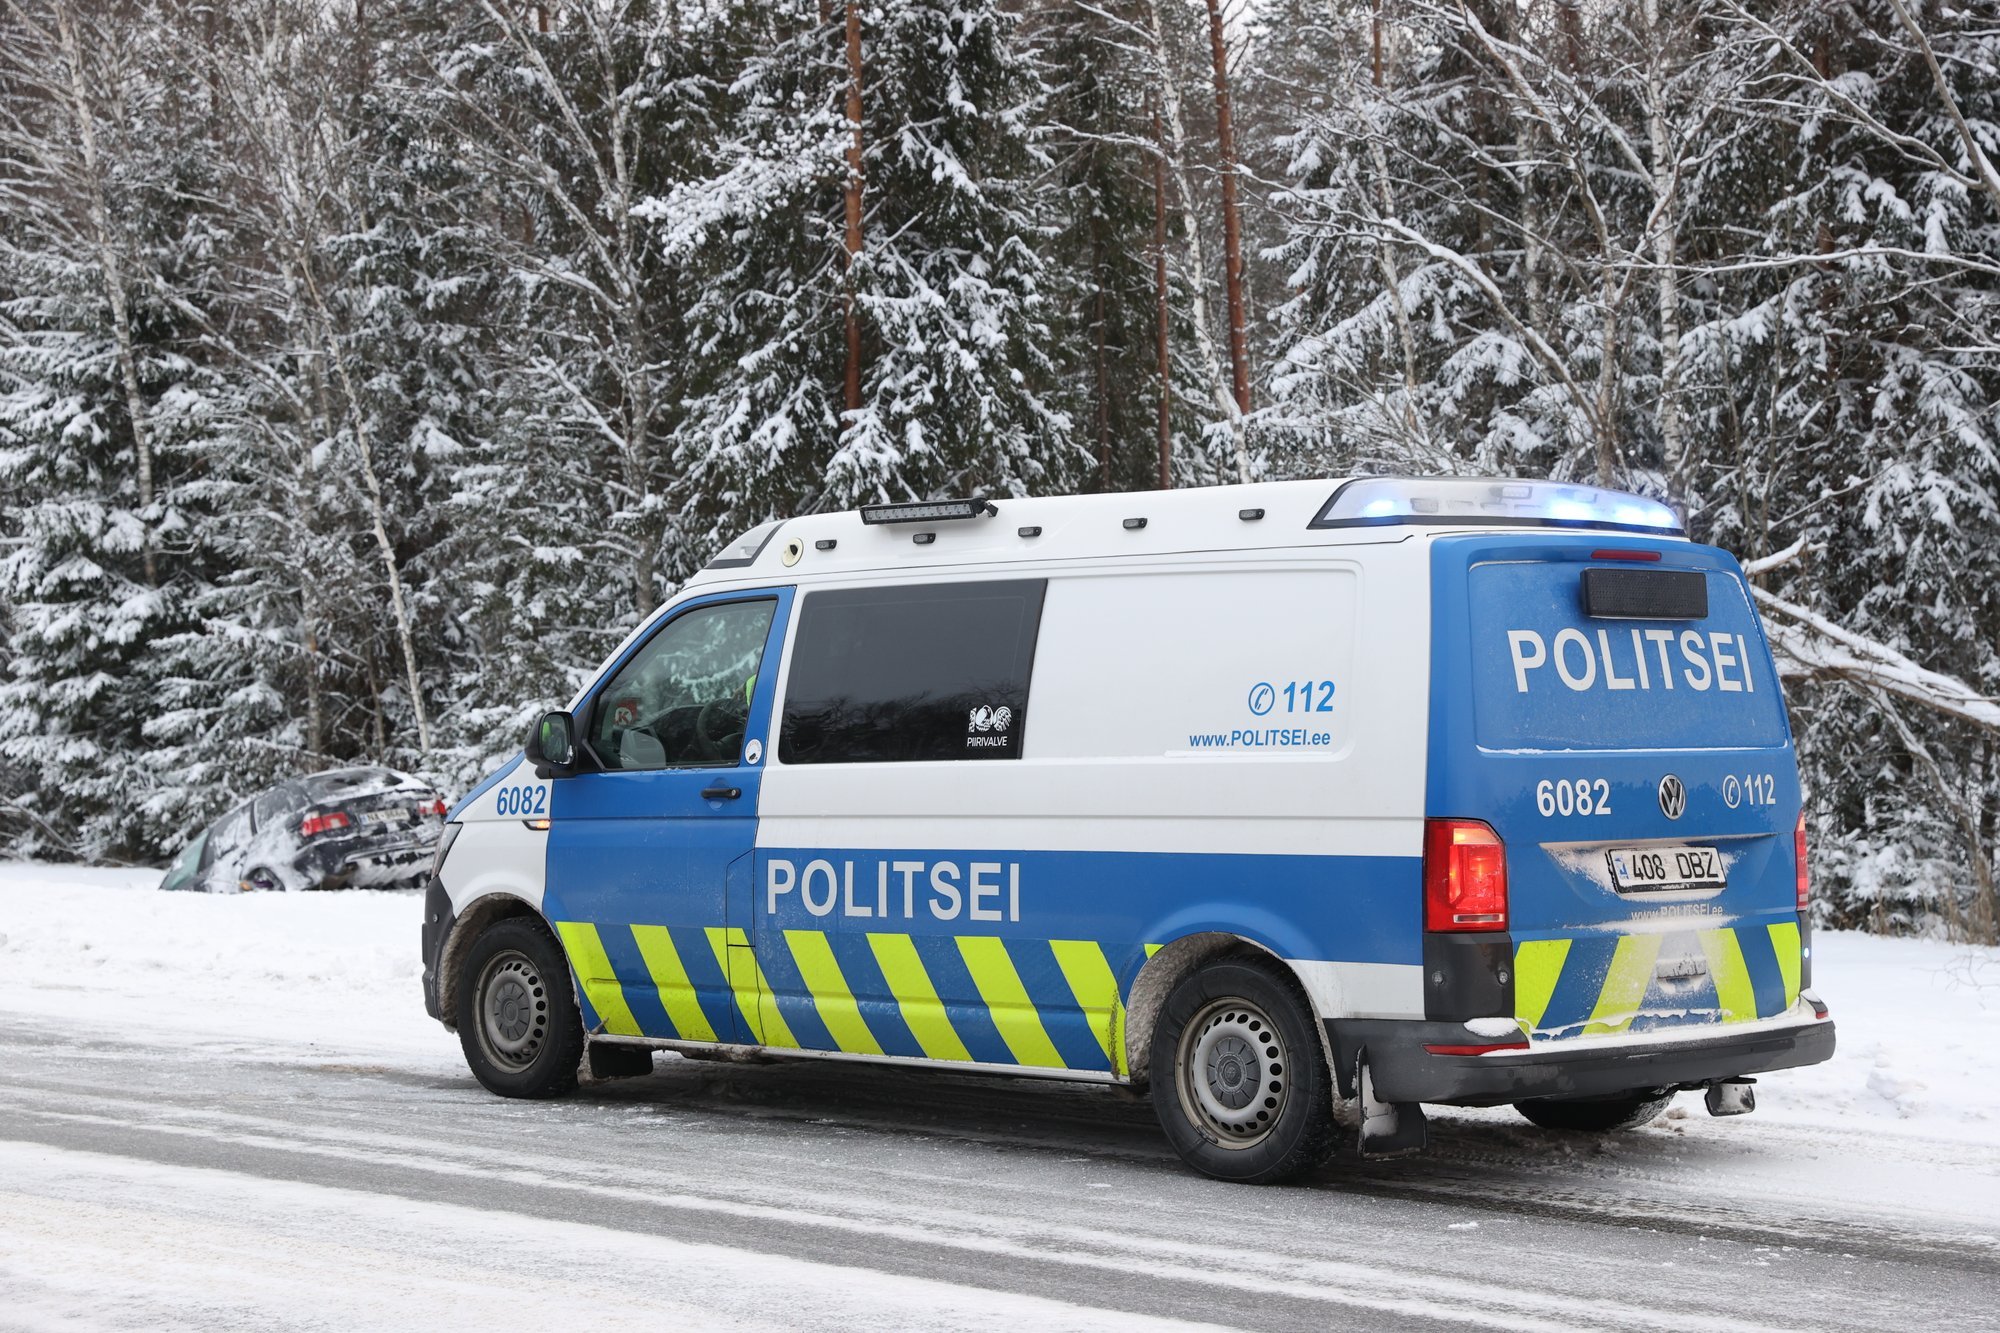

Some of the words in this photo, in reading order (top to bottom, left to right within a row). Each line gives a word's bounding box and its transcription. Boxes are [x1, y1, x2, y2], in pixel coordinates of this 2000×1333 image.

[1507, 627, 1754, 693] POLITSEI
[1283, 680, 1336, 713] 112
[967, 736, 1008, 747] PIIRIVALVE
[1189, 729, 1331, 747] www.POLITSEI.ee
[496, 785, 546, 816] 6082
[1536, 778, 1612, 817] 6082
[1744, 774, 1776, 805] 112
[1632, 853, 1666, 880] 408
[1675, 851, 1719, 879] DBZ
[767, 858, 1020, 923] POLITSEI
